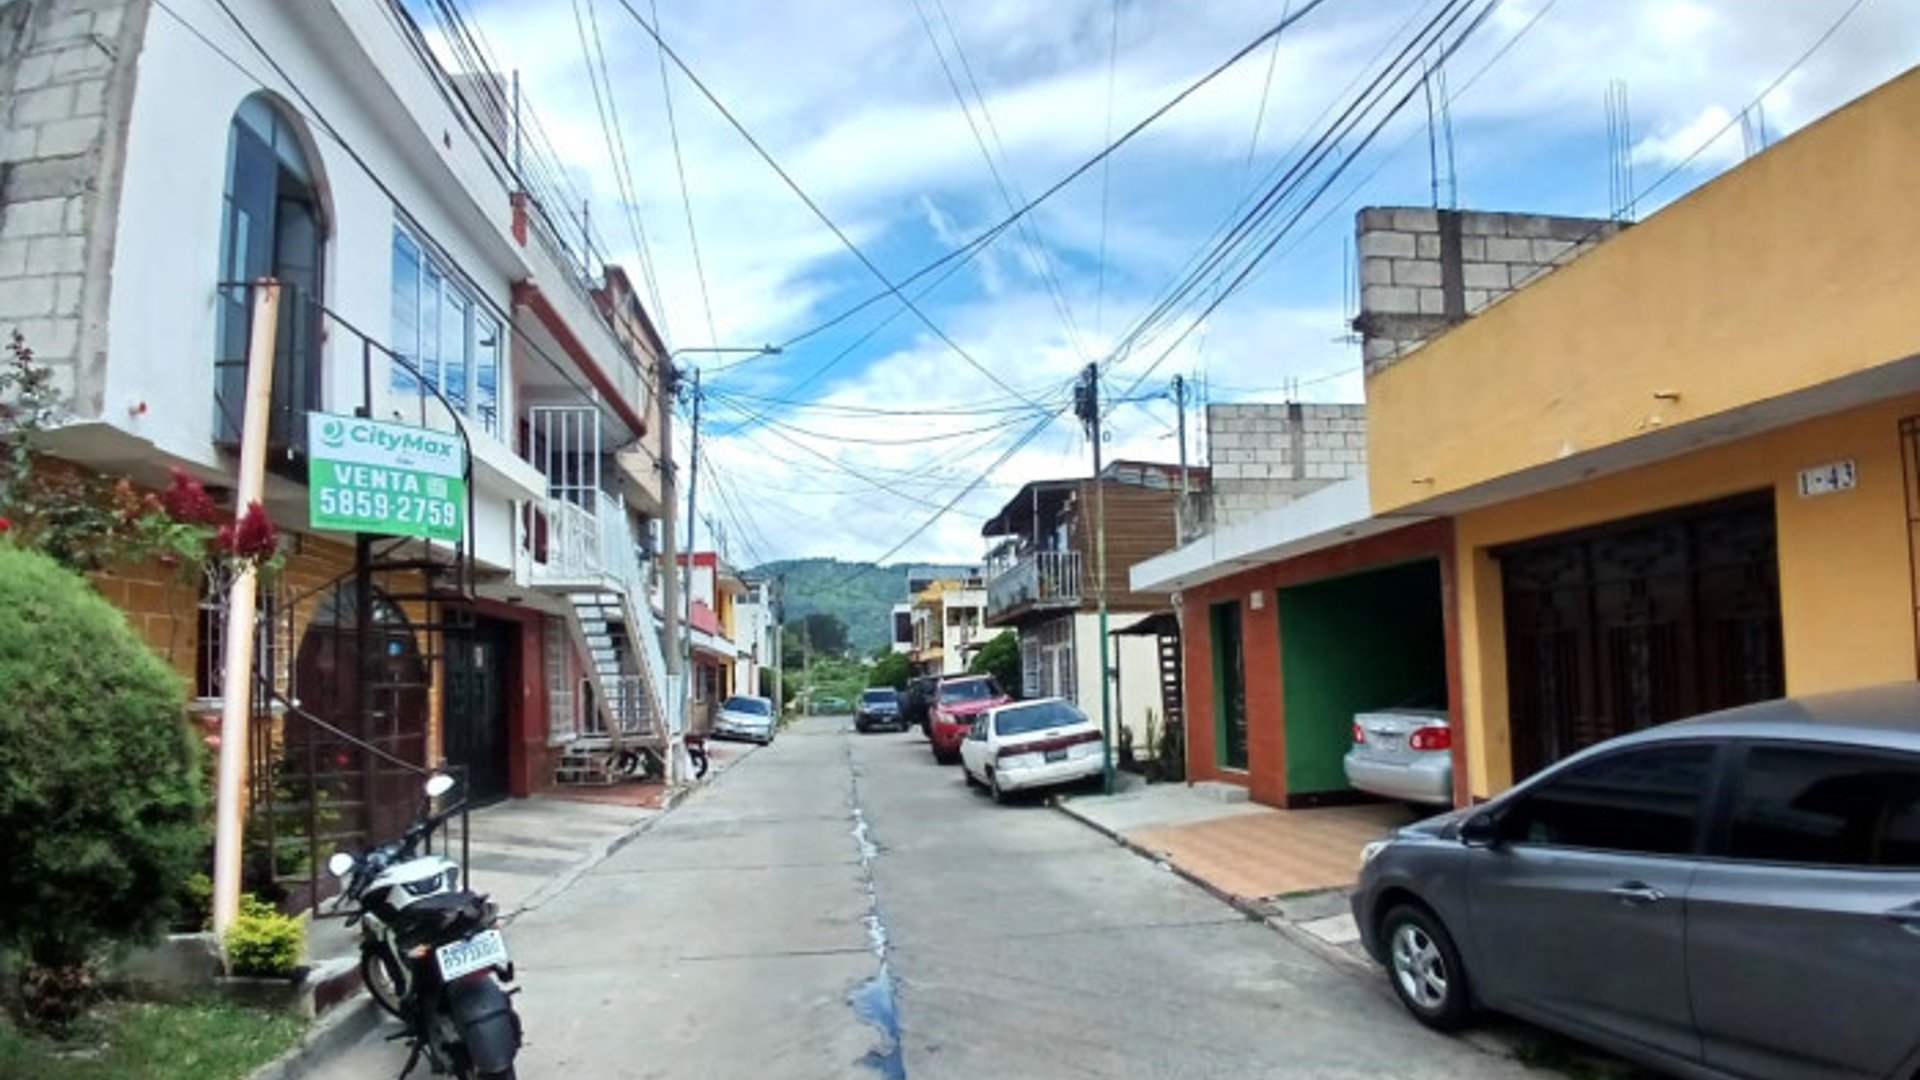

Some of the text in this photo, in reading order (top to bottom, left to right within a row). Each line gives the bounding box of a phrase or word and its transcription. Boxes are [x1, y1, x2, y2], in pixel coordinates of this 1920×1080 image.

[350, 425, 453, 457] CityMax
[333, 463, 420, 494] VENTA
[319, 487, 456, 527] 5859-2759
